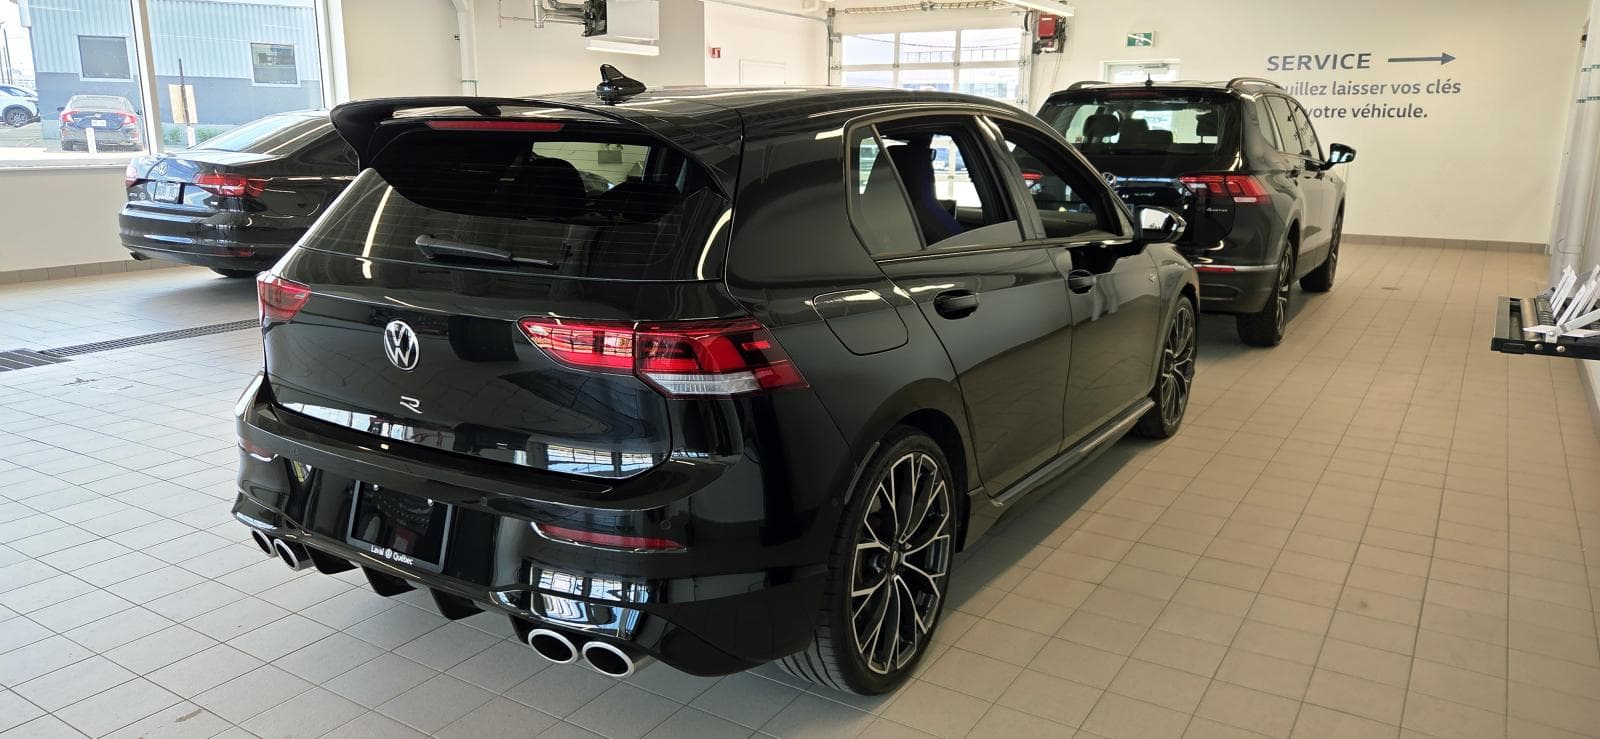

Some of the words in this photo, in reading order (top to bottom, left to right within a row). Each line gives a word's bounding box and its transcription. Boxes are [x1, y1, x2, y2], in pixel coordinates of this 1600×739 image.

[1267, 53, 1372, 71] SERVICE
[1332, 81, 1387, 96] laisser
[1391, 81, 1421, 94] vos
[1426, 78, 1461, 94] clés
[1351, 103, 1428, 118] véhicule.
[371, 544, 385, 556] Laval
